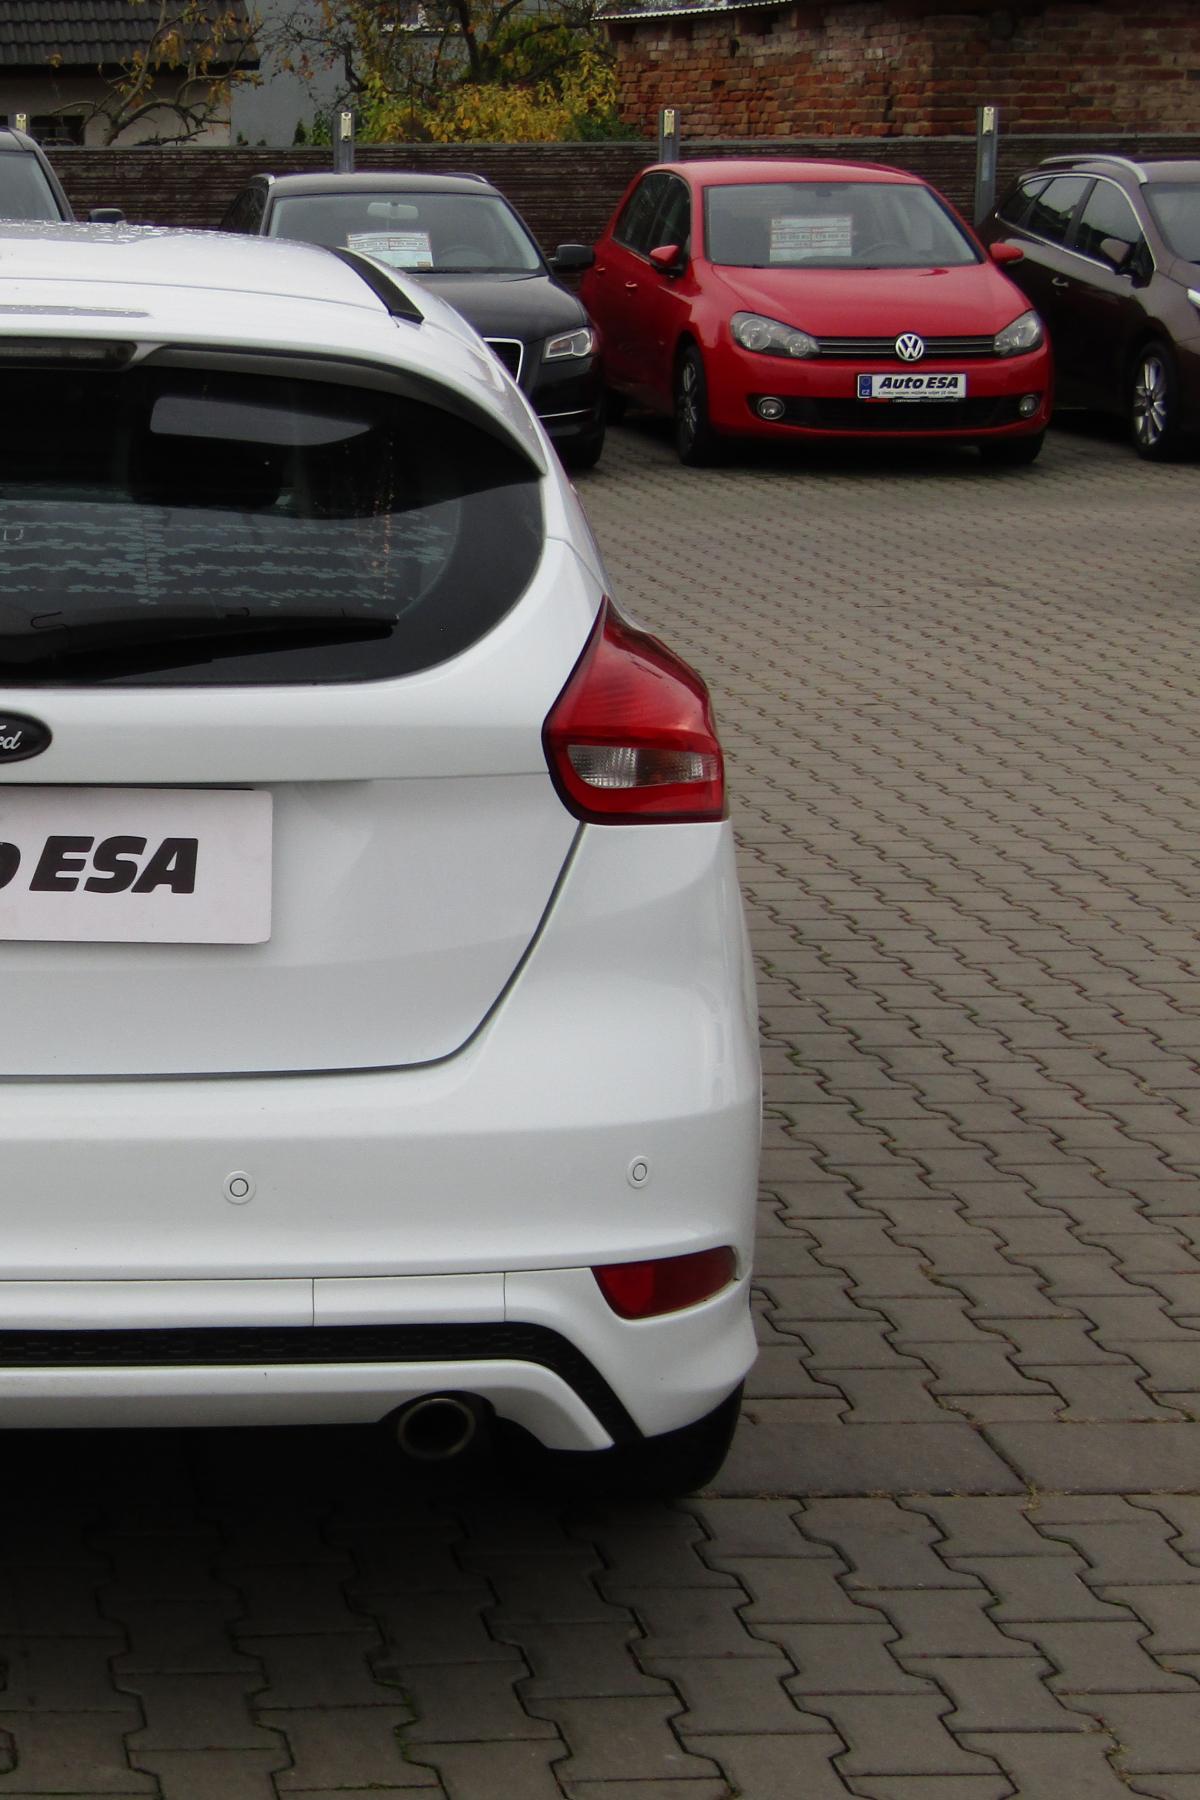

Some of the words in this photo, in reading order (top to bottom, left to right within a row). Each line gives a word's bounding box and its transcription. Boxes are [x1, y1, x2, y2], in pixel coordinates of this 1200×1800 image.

[879, 376, 924, 389] Auto
[925, 376, 959, 389] ESA
[28, 834, 199, 894] ESA
